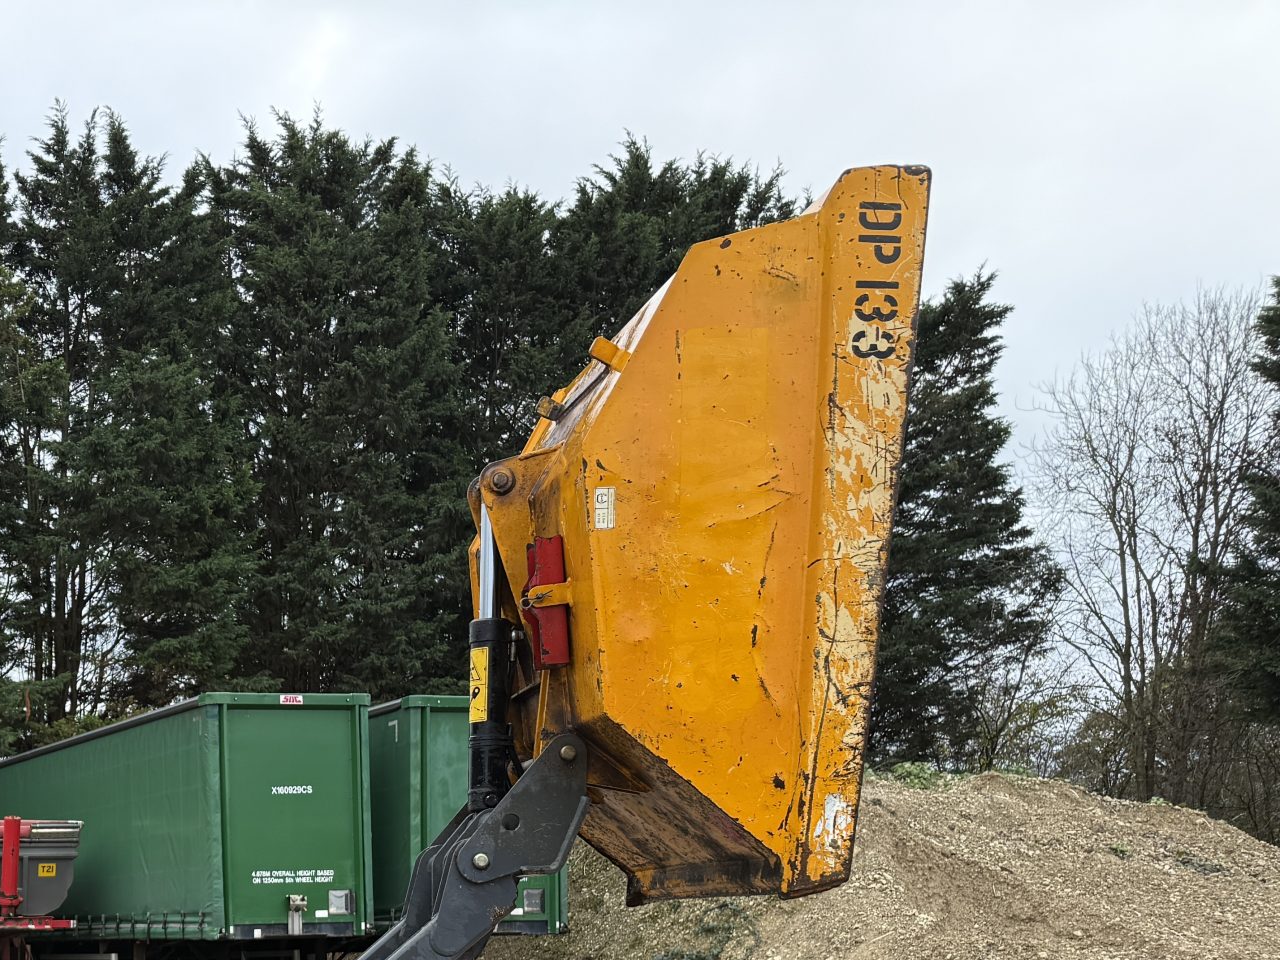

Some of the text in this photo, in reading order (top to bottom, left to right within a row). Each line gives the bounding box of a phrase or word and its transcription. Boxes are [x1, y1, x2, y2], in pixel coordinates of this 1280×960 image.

[851, 201, 902, 359] DP 133
[271, 869, 295, 877] OVERALL
[296, 869, 315, 877] HEIGHT
